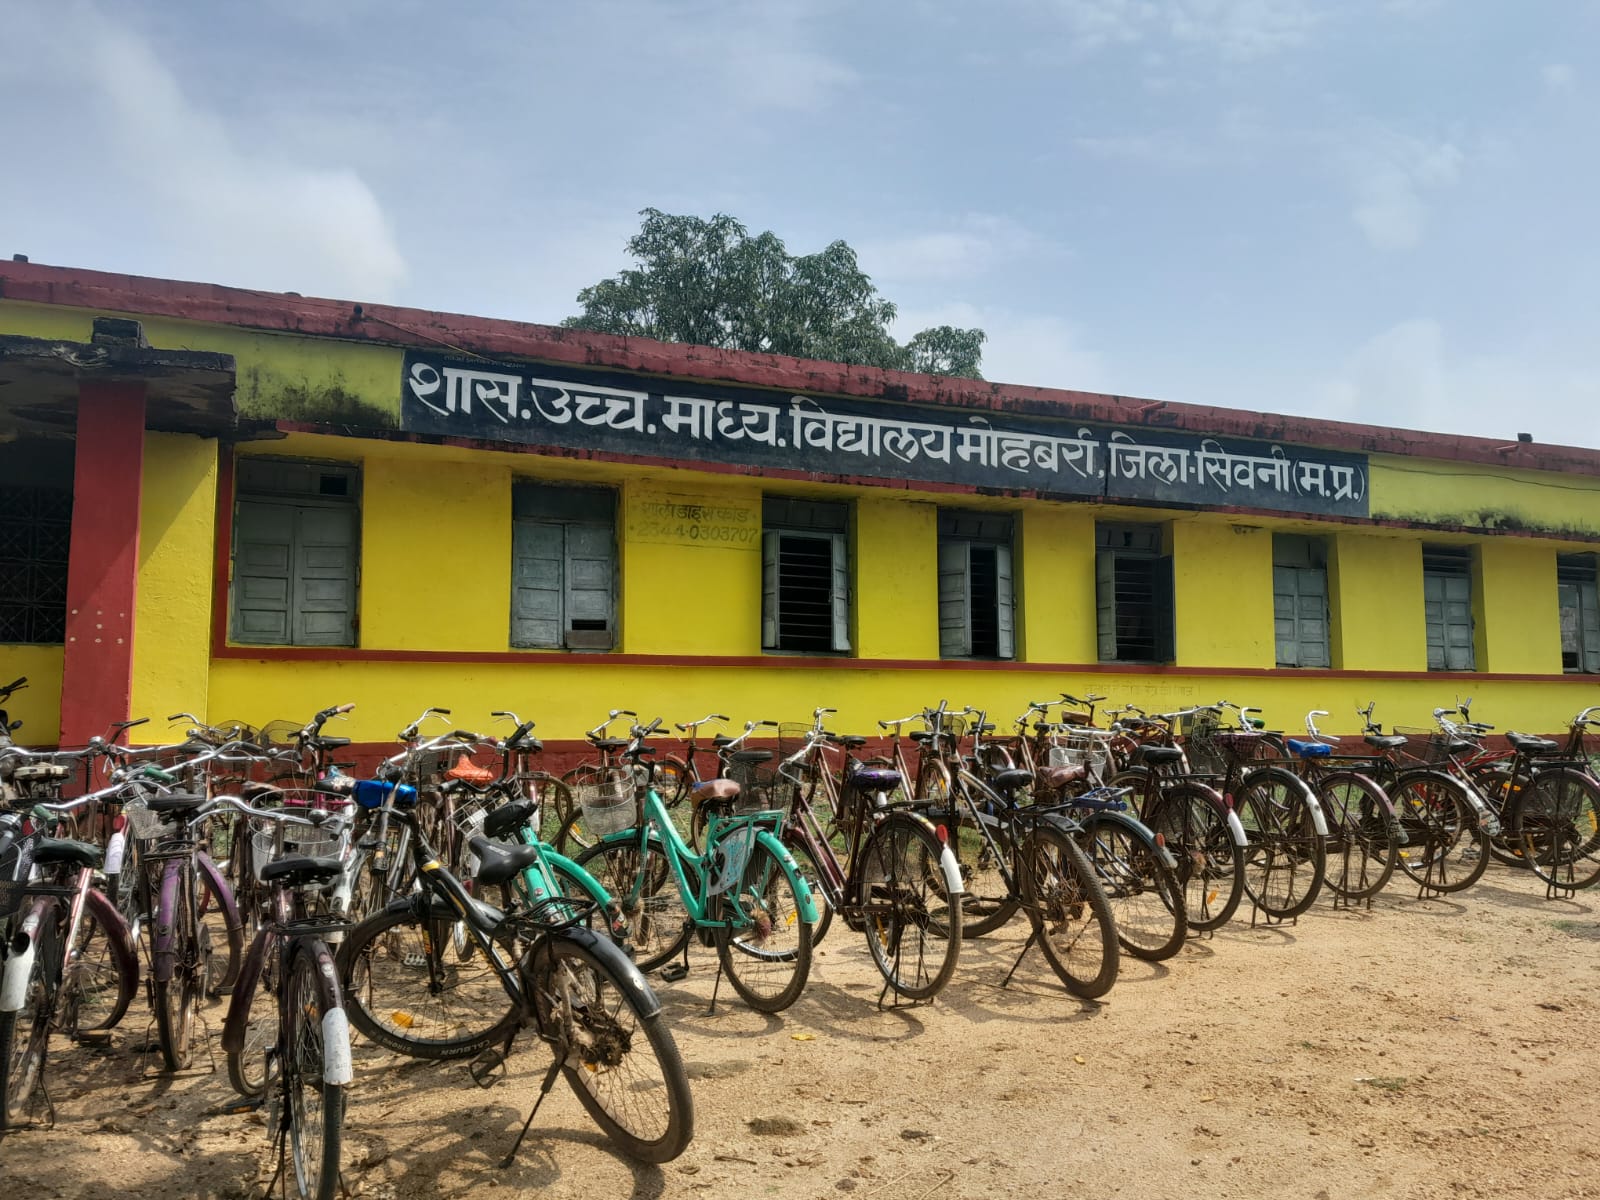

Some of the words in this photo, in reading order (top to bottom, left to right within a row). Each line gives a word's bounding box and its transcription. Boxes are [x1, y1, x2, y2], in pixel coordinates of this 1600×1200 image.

[409, 363, 530, 424] शास.
[532, 378, 656, 435] उच्च.
[663, 396, 785, 449] माध्य.
[788, 395, 954, 464] विद्यालय
